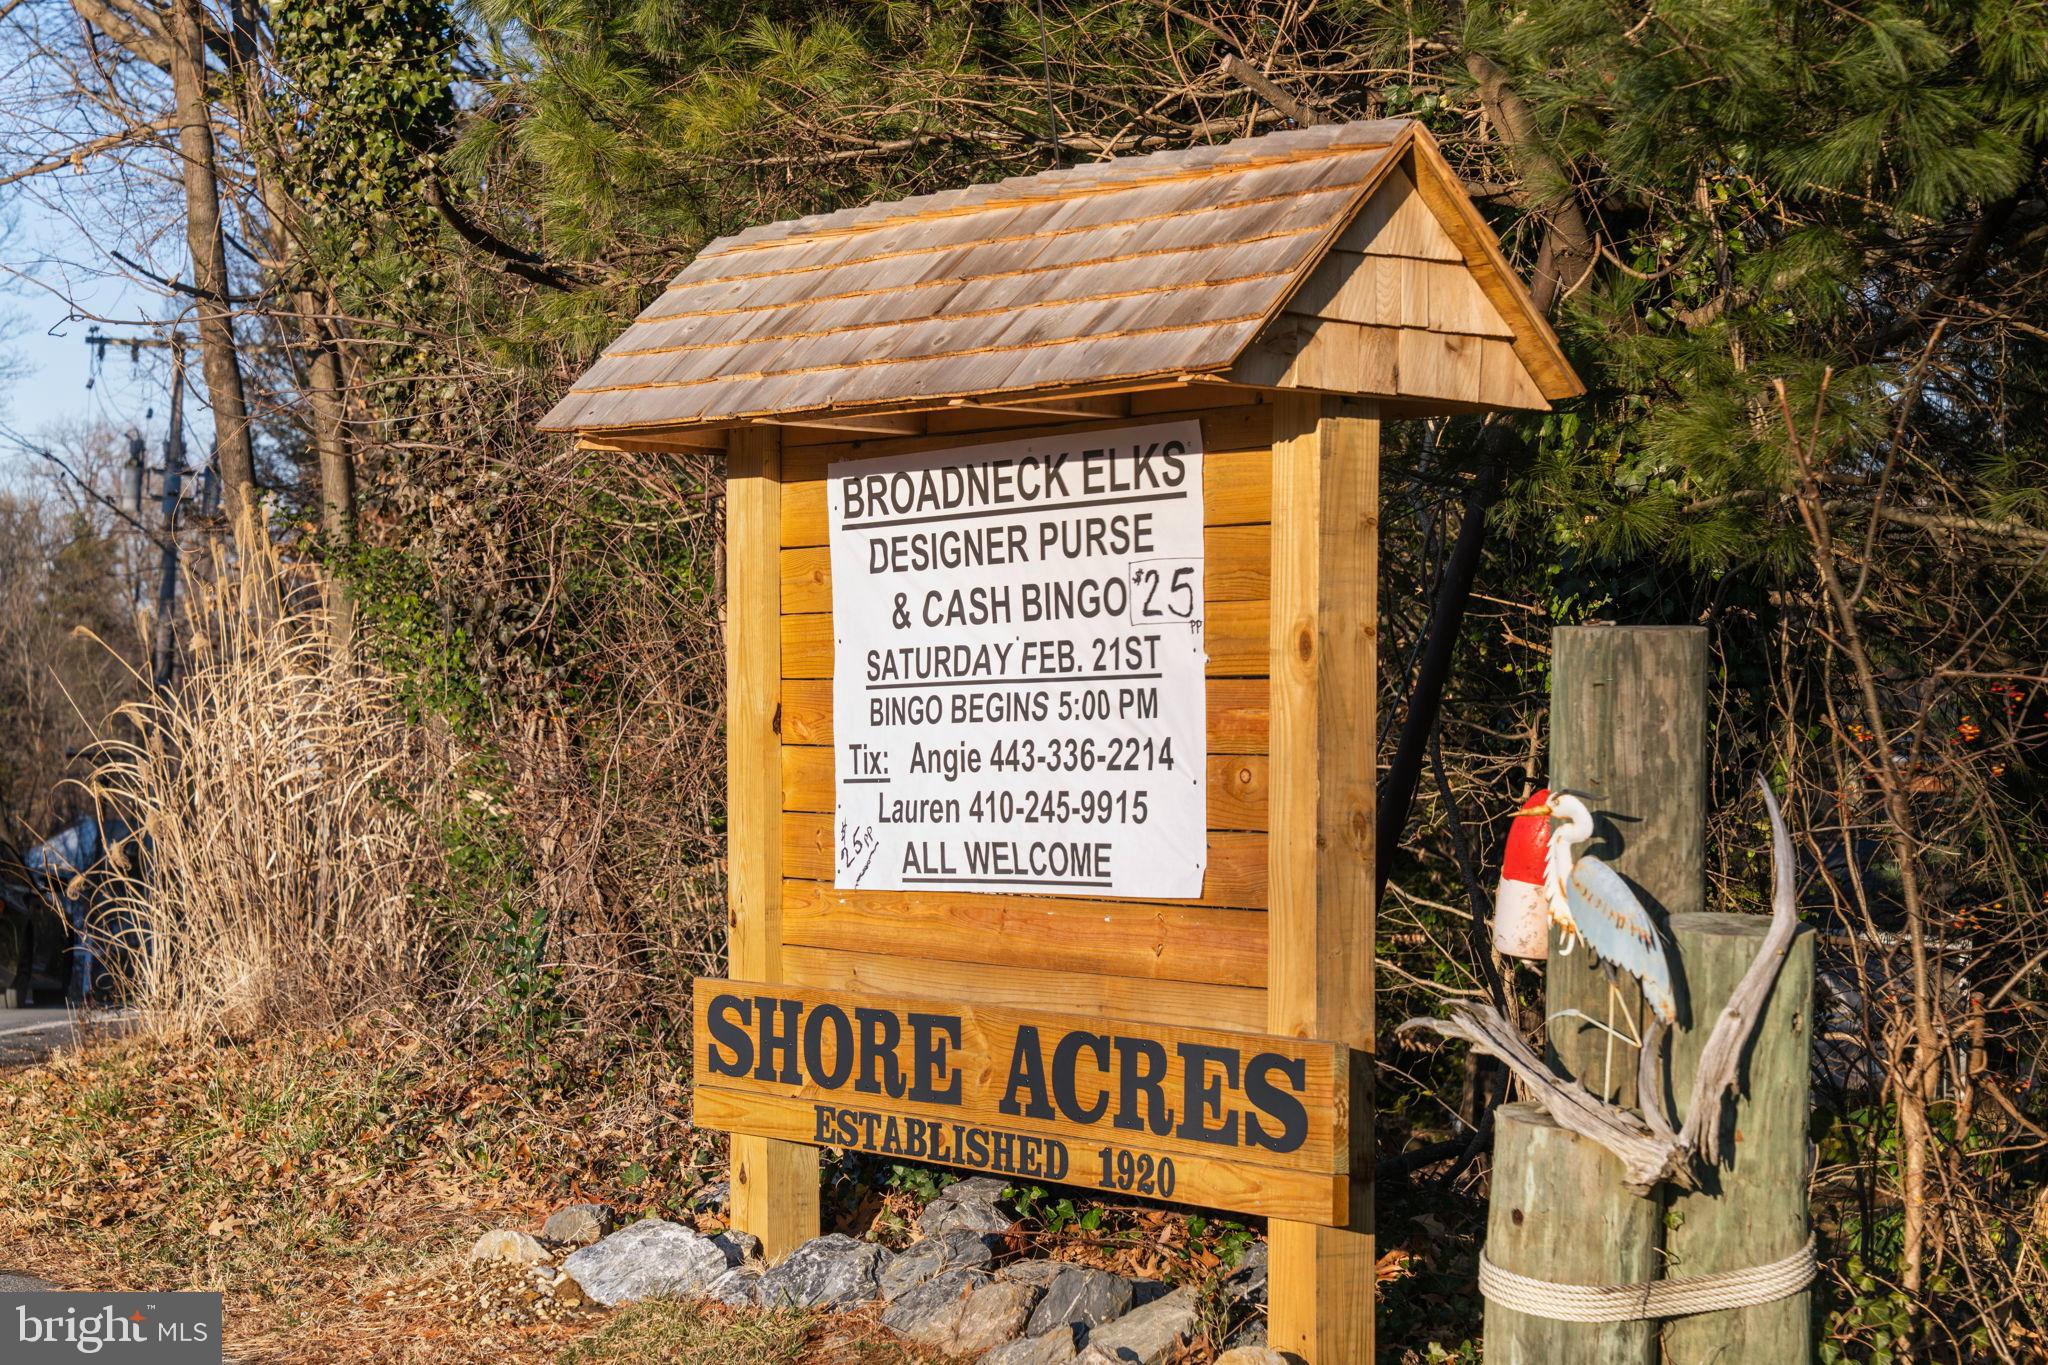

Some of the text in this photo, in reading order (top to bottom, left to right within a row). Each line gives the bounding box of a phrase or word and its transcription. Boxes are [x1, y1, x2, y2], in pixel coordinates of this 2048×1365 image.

[843, 440, 1186, 519] BROADNECK ELKS
[869, 513, 1154, 573] DESIGNER PURSE
[892, 577, 1127, 629] & CASH BINGO
[1132, 566, 1194, 618] $25
[866, 635, 1161, 682] SATURDAY FEB. 21ST
[870, 687, 1158, 727] BINGO BEGINS 5:00 PM
[849, 737, 1174, 782] Tix: Angie 443-336-2214
[879, 790, 1149, 824] Lauren 410-245-9915
[902, 841, 1112, 877] ALL WELCOME
[706, 995, 1309, 1154] SHORE ACRES
[814, 1105, 1175, 1198] ESTABLISHED 1920
